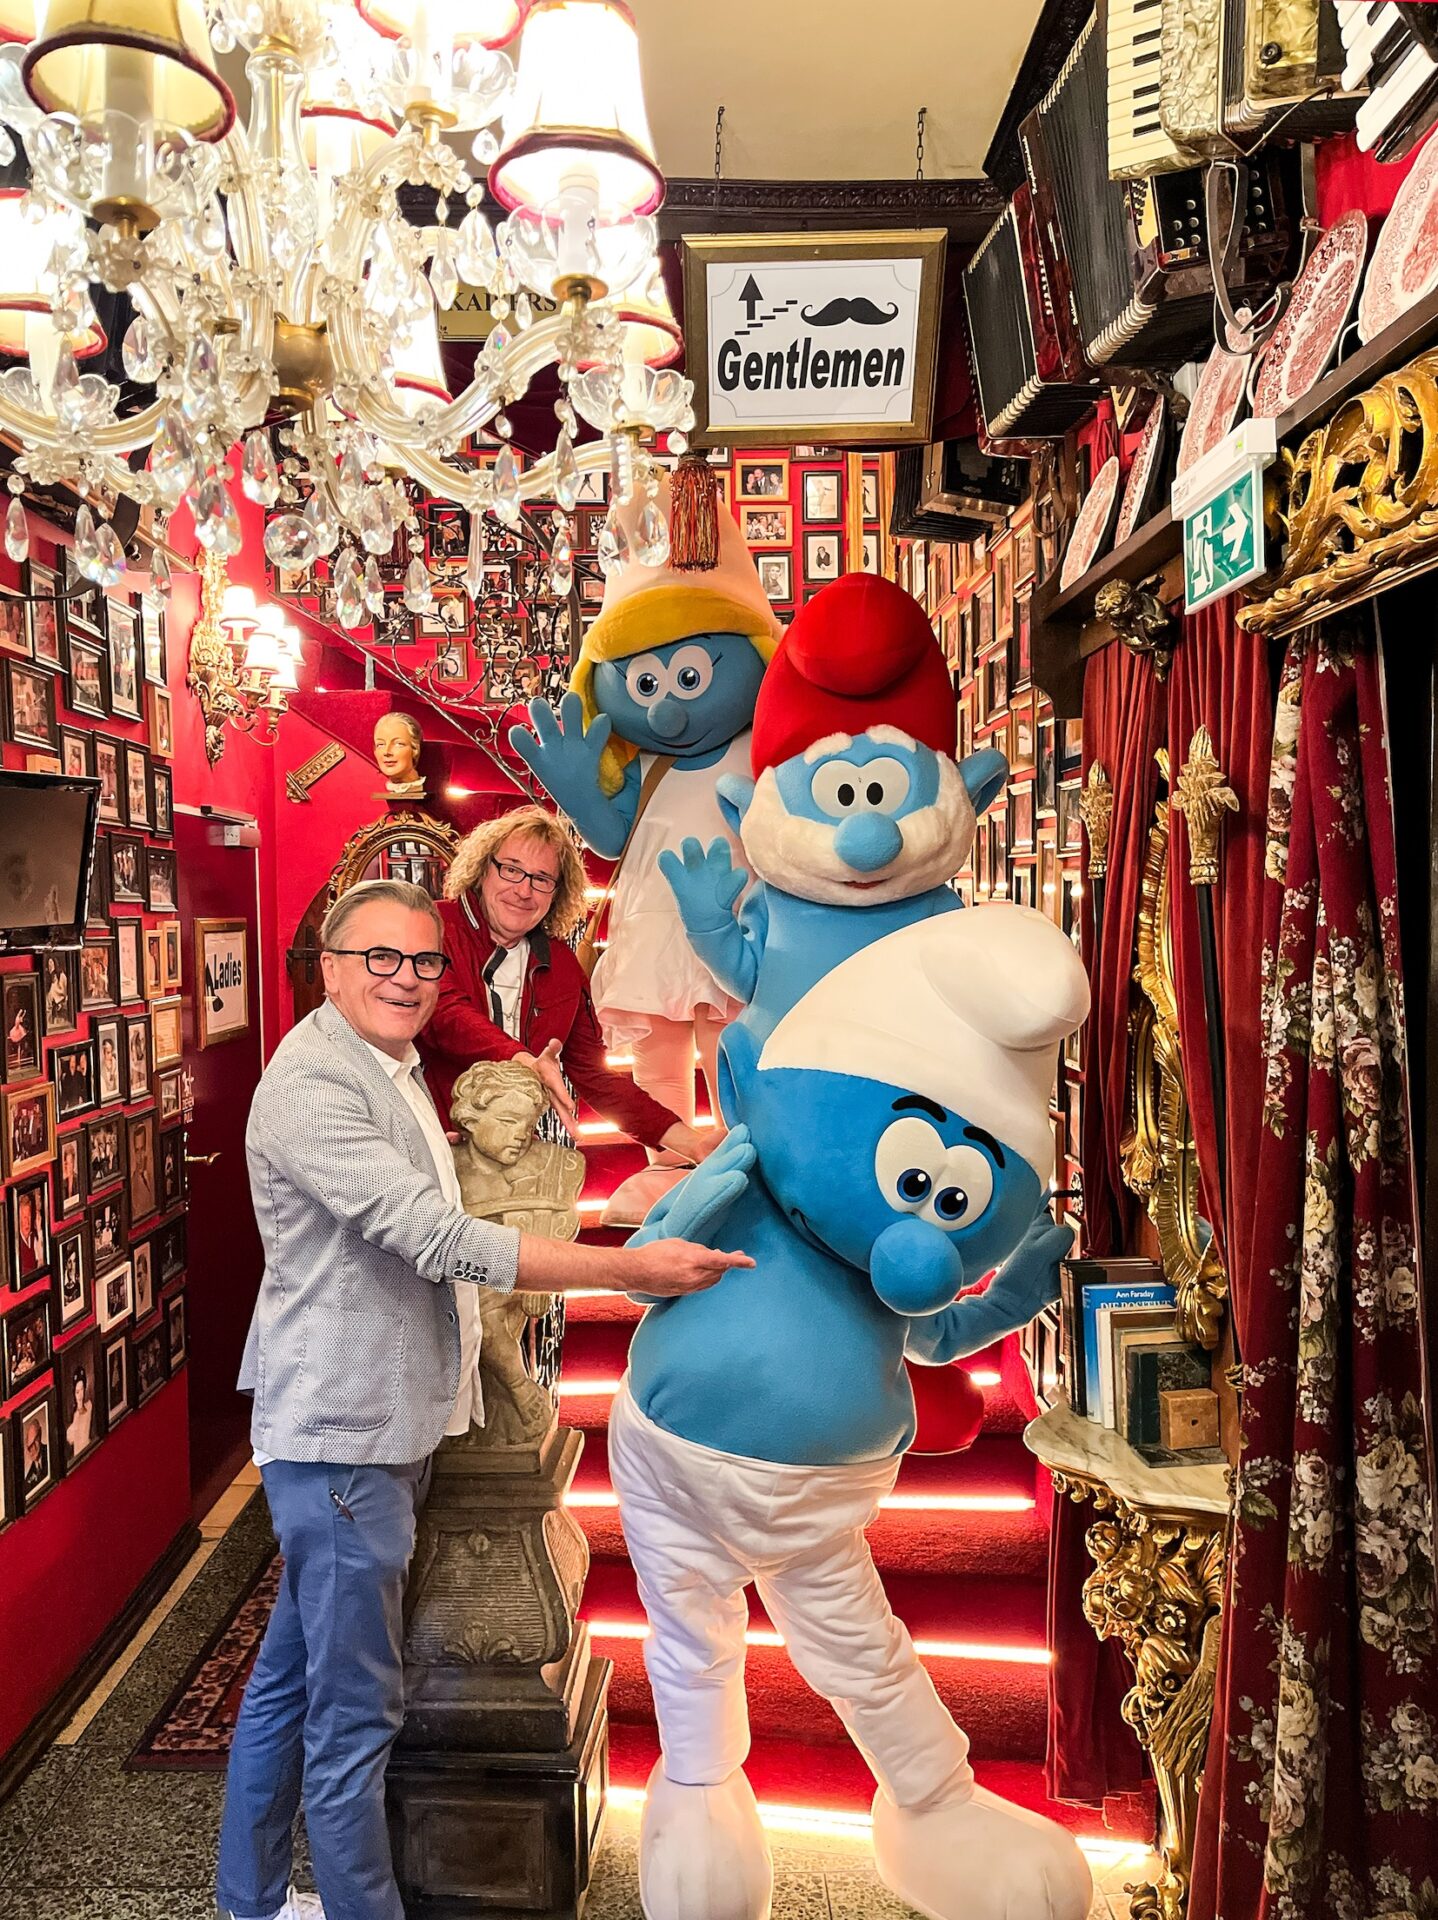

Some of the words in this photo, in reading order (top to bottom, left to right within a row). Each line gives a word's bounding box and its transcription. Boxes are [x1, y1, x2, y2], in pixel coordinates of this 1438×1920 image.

[717, 337, 905, 391] Gentlemen
[213, 952, 242, 990] Ladies
[1116, 1290, 1129, 1298] Ann
[1131, 1290, 1154, 1299] Faraday
